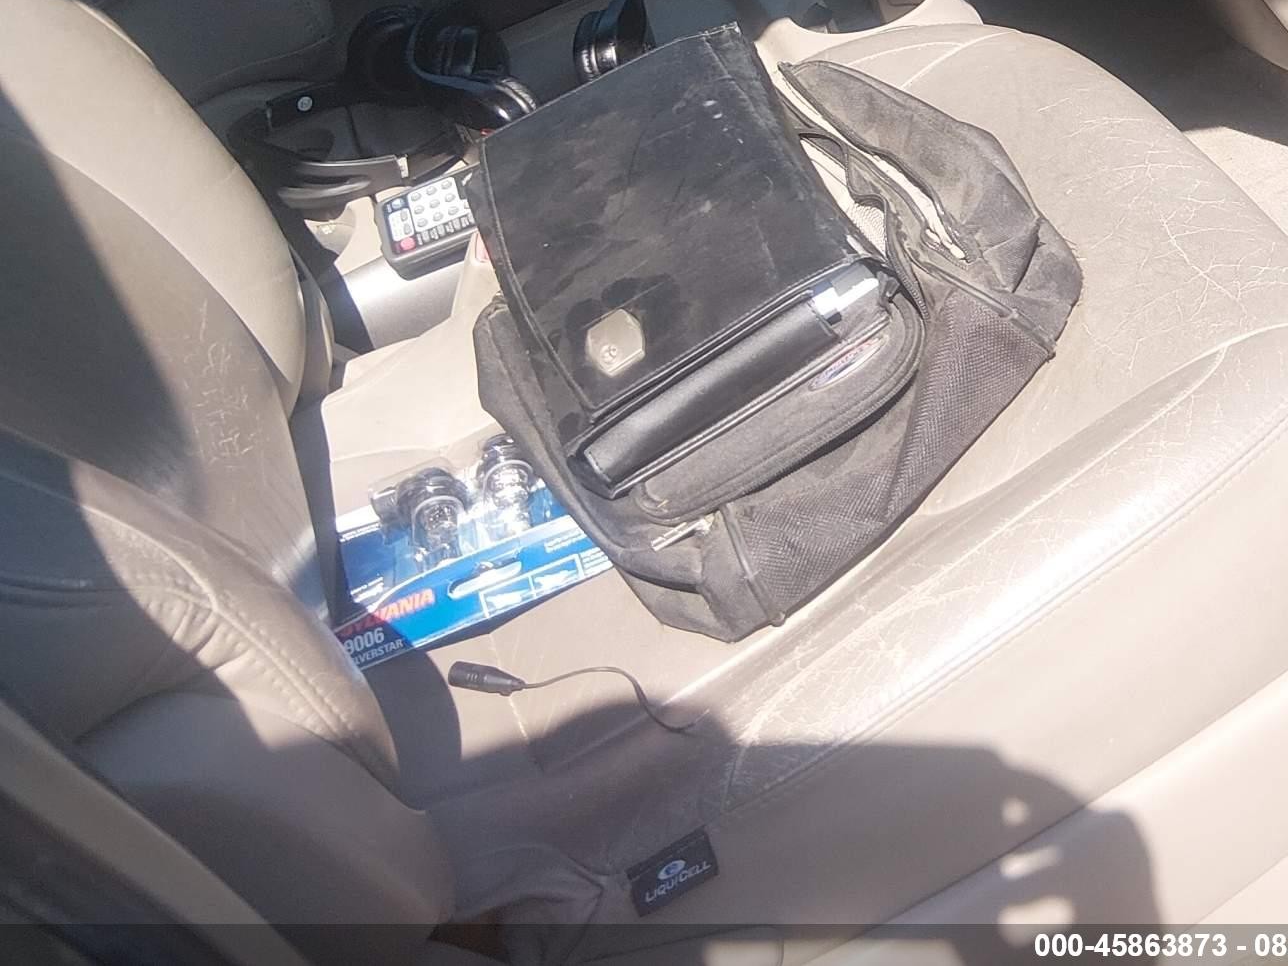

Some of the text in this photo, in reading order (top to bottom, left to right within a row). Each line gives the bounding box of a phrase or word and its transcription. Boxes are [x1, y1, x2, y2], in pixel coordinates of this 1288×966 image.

[343, 626, 386, 656] 9006
[353, 639, 404, 665] LVERSTAR
[644, 860, 713, 903] LIQUICELL
